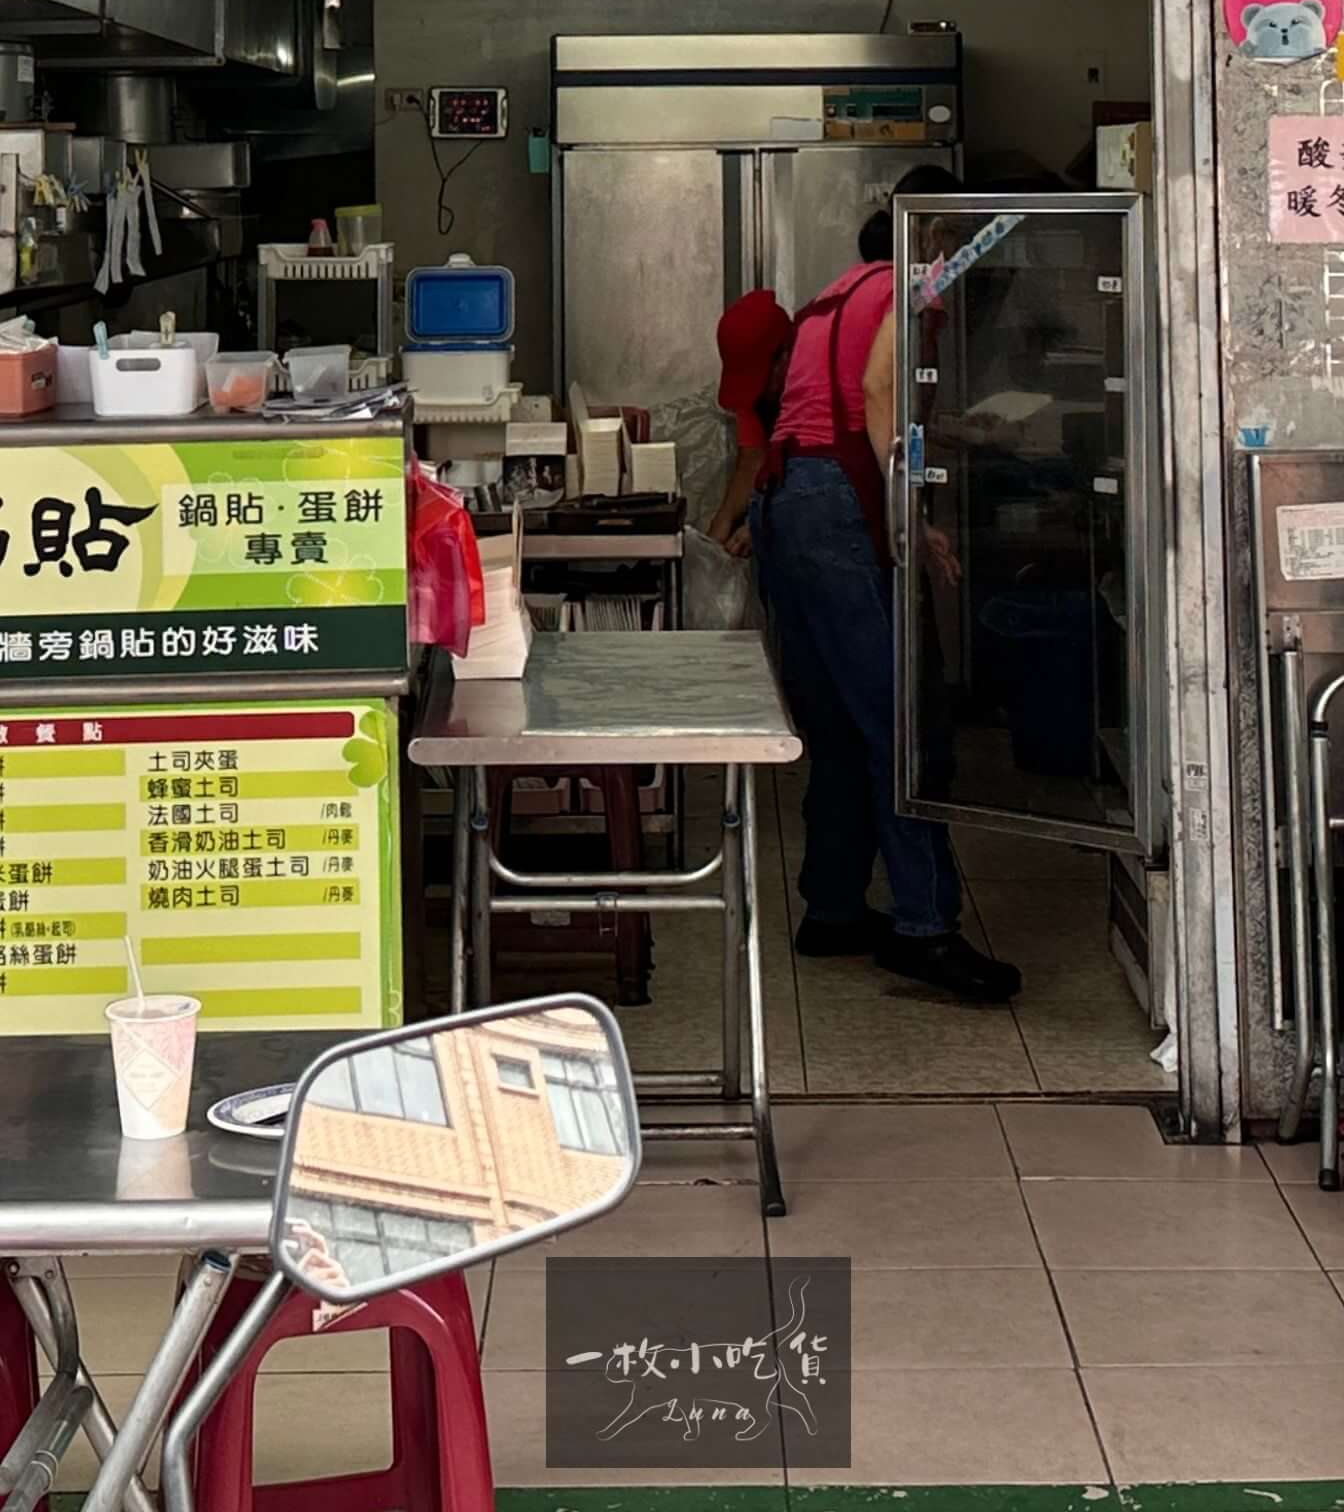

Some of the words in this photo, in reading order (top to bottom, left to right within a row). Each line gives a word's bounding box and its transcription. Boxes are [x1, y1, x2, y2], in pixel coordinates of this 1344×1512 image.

[243, 531, 330, 567] 專賣
[148, 749, 239, 772] 土司夾蛋
[148, 776, 239, 799] 蜂蜜土司
[148, 803, 239, 826] 法國土司
[148, 829, 286, 854] 香滑奶油土司
[148, 856, 310, 881] 奶油火腿蛋土司
[148, 885, 240, 909] 燒肉土司
